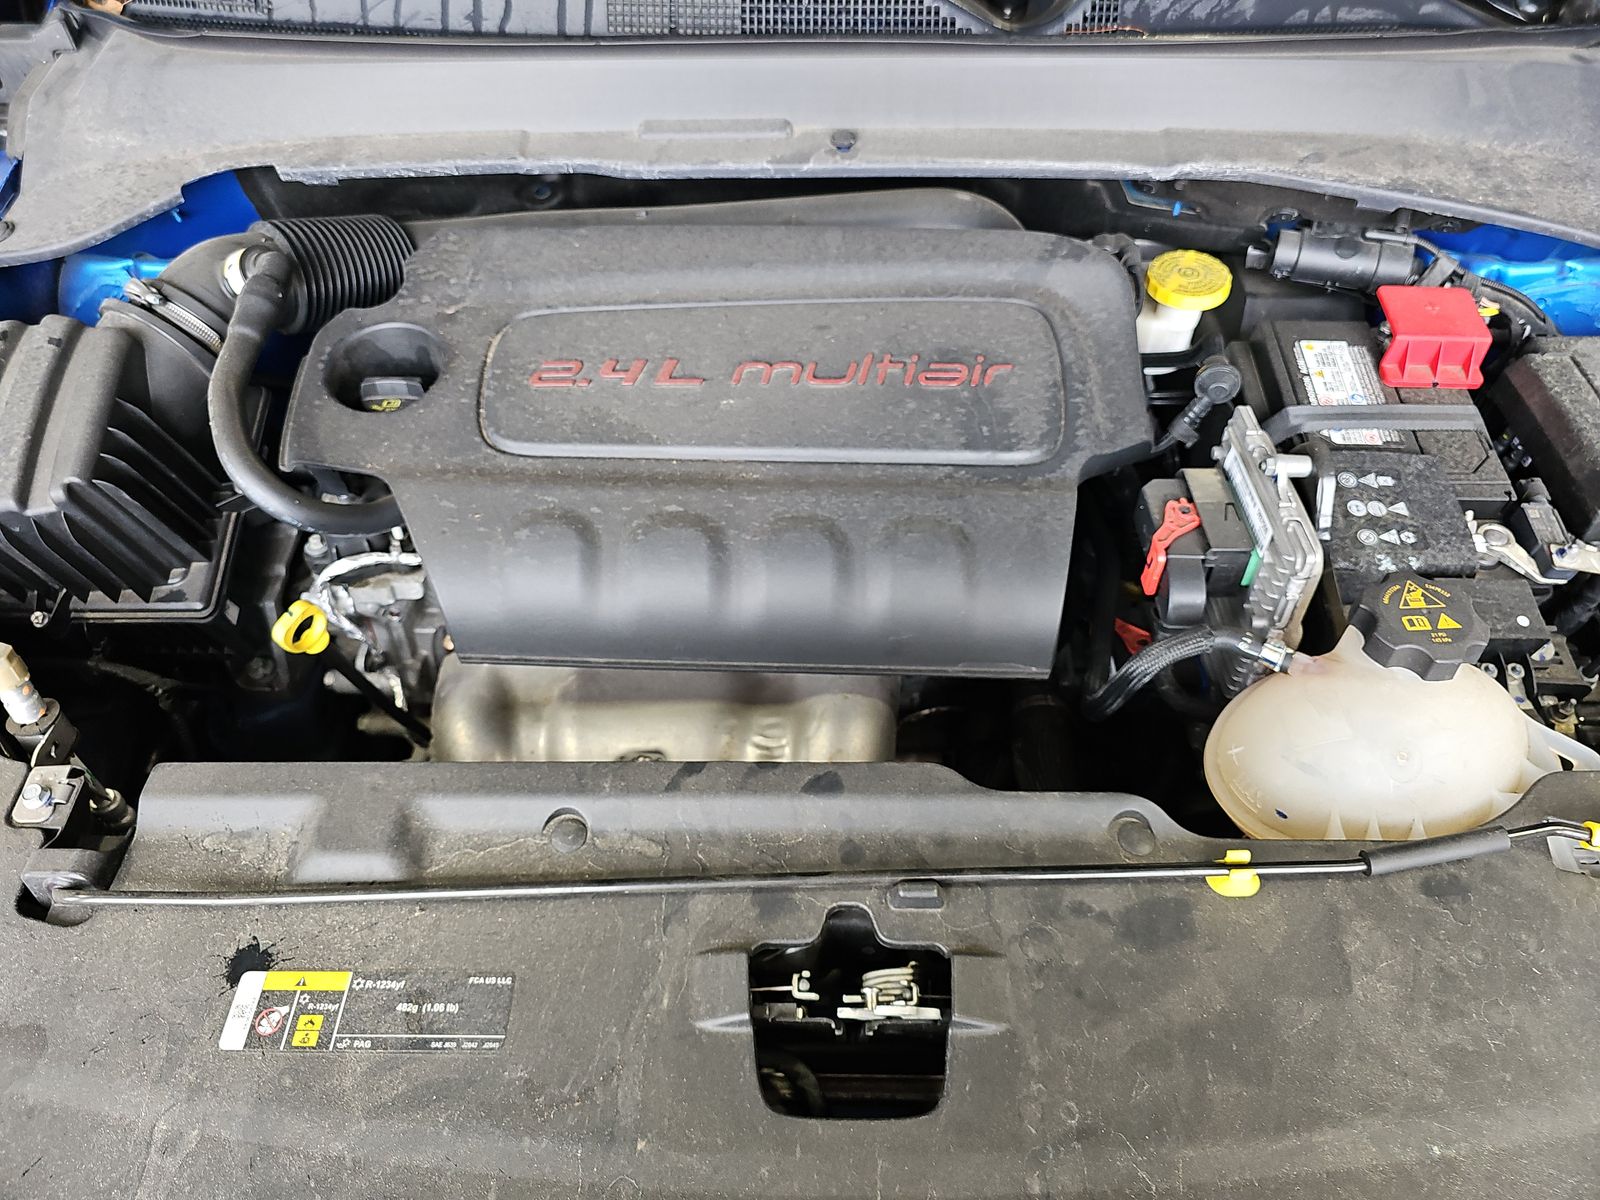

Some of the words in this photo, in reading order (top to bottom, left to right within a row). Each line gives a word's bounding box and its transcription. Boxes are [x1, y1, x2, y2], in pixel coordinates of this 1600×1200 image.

[730, 351, 1016, 388] multiair
[364, 979, 406, 991] R-1234yf
[468, 976, 485, 985] FCA
[485, 976, 496, 985] US
[497, 976, 513, 985] LLC
[395, 1002, 419, 1014] 482g
[446, 1002, 460, 1014] lb)
[353, 1039, 372, 1049] PAG
